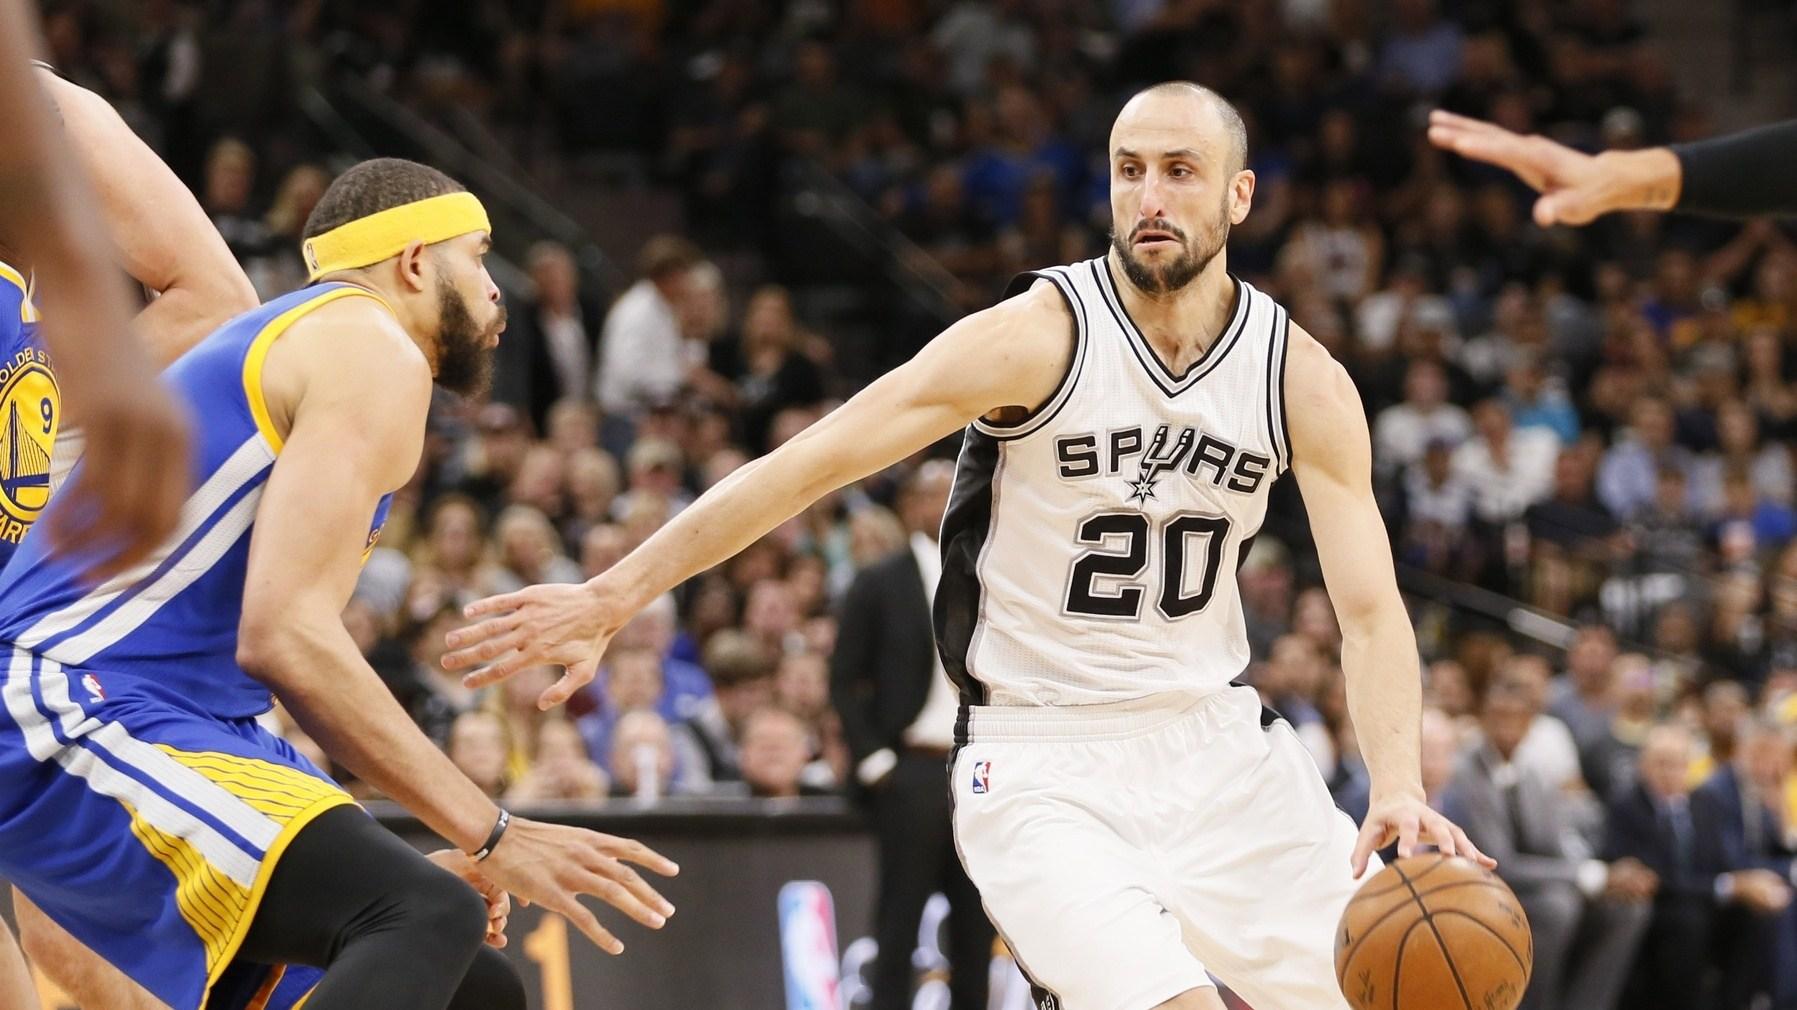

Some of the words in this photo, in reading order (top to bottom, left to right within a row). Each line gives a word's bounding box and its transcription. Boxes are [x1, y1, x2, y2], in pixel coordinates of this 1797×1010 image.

[40, 397, 53, 434] 9
[1053, 425, 1271, 505] SPURS
[1060, 511, 1233, 621] 20
